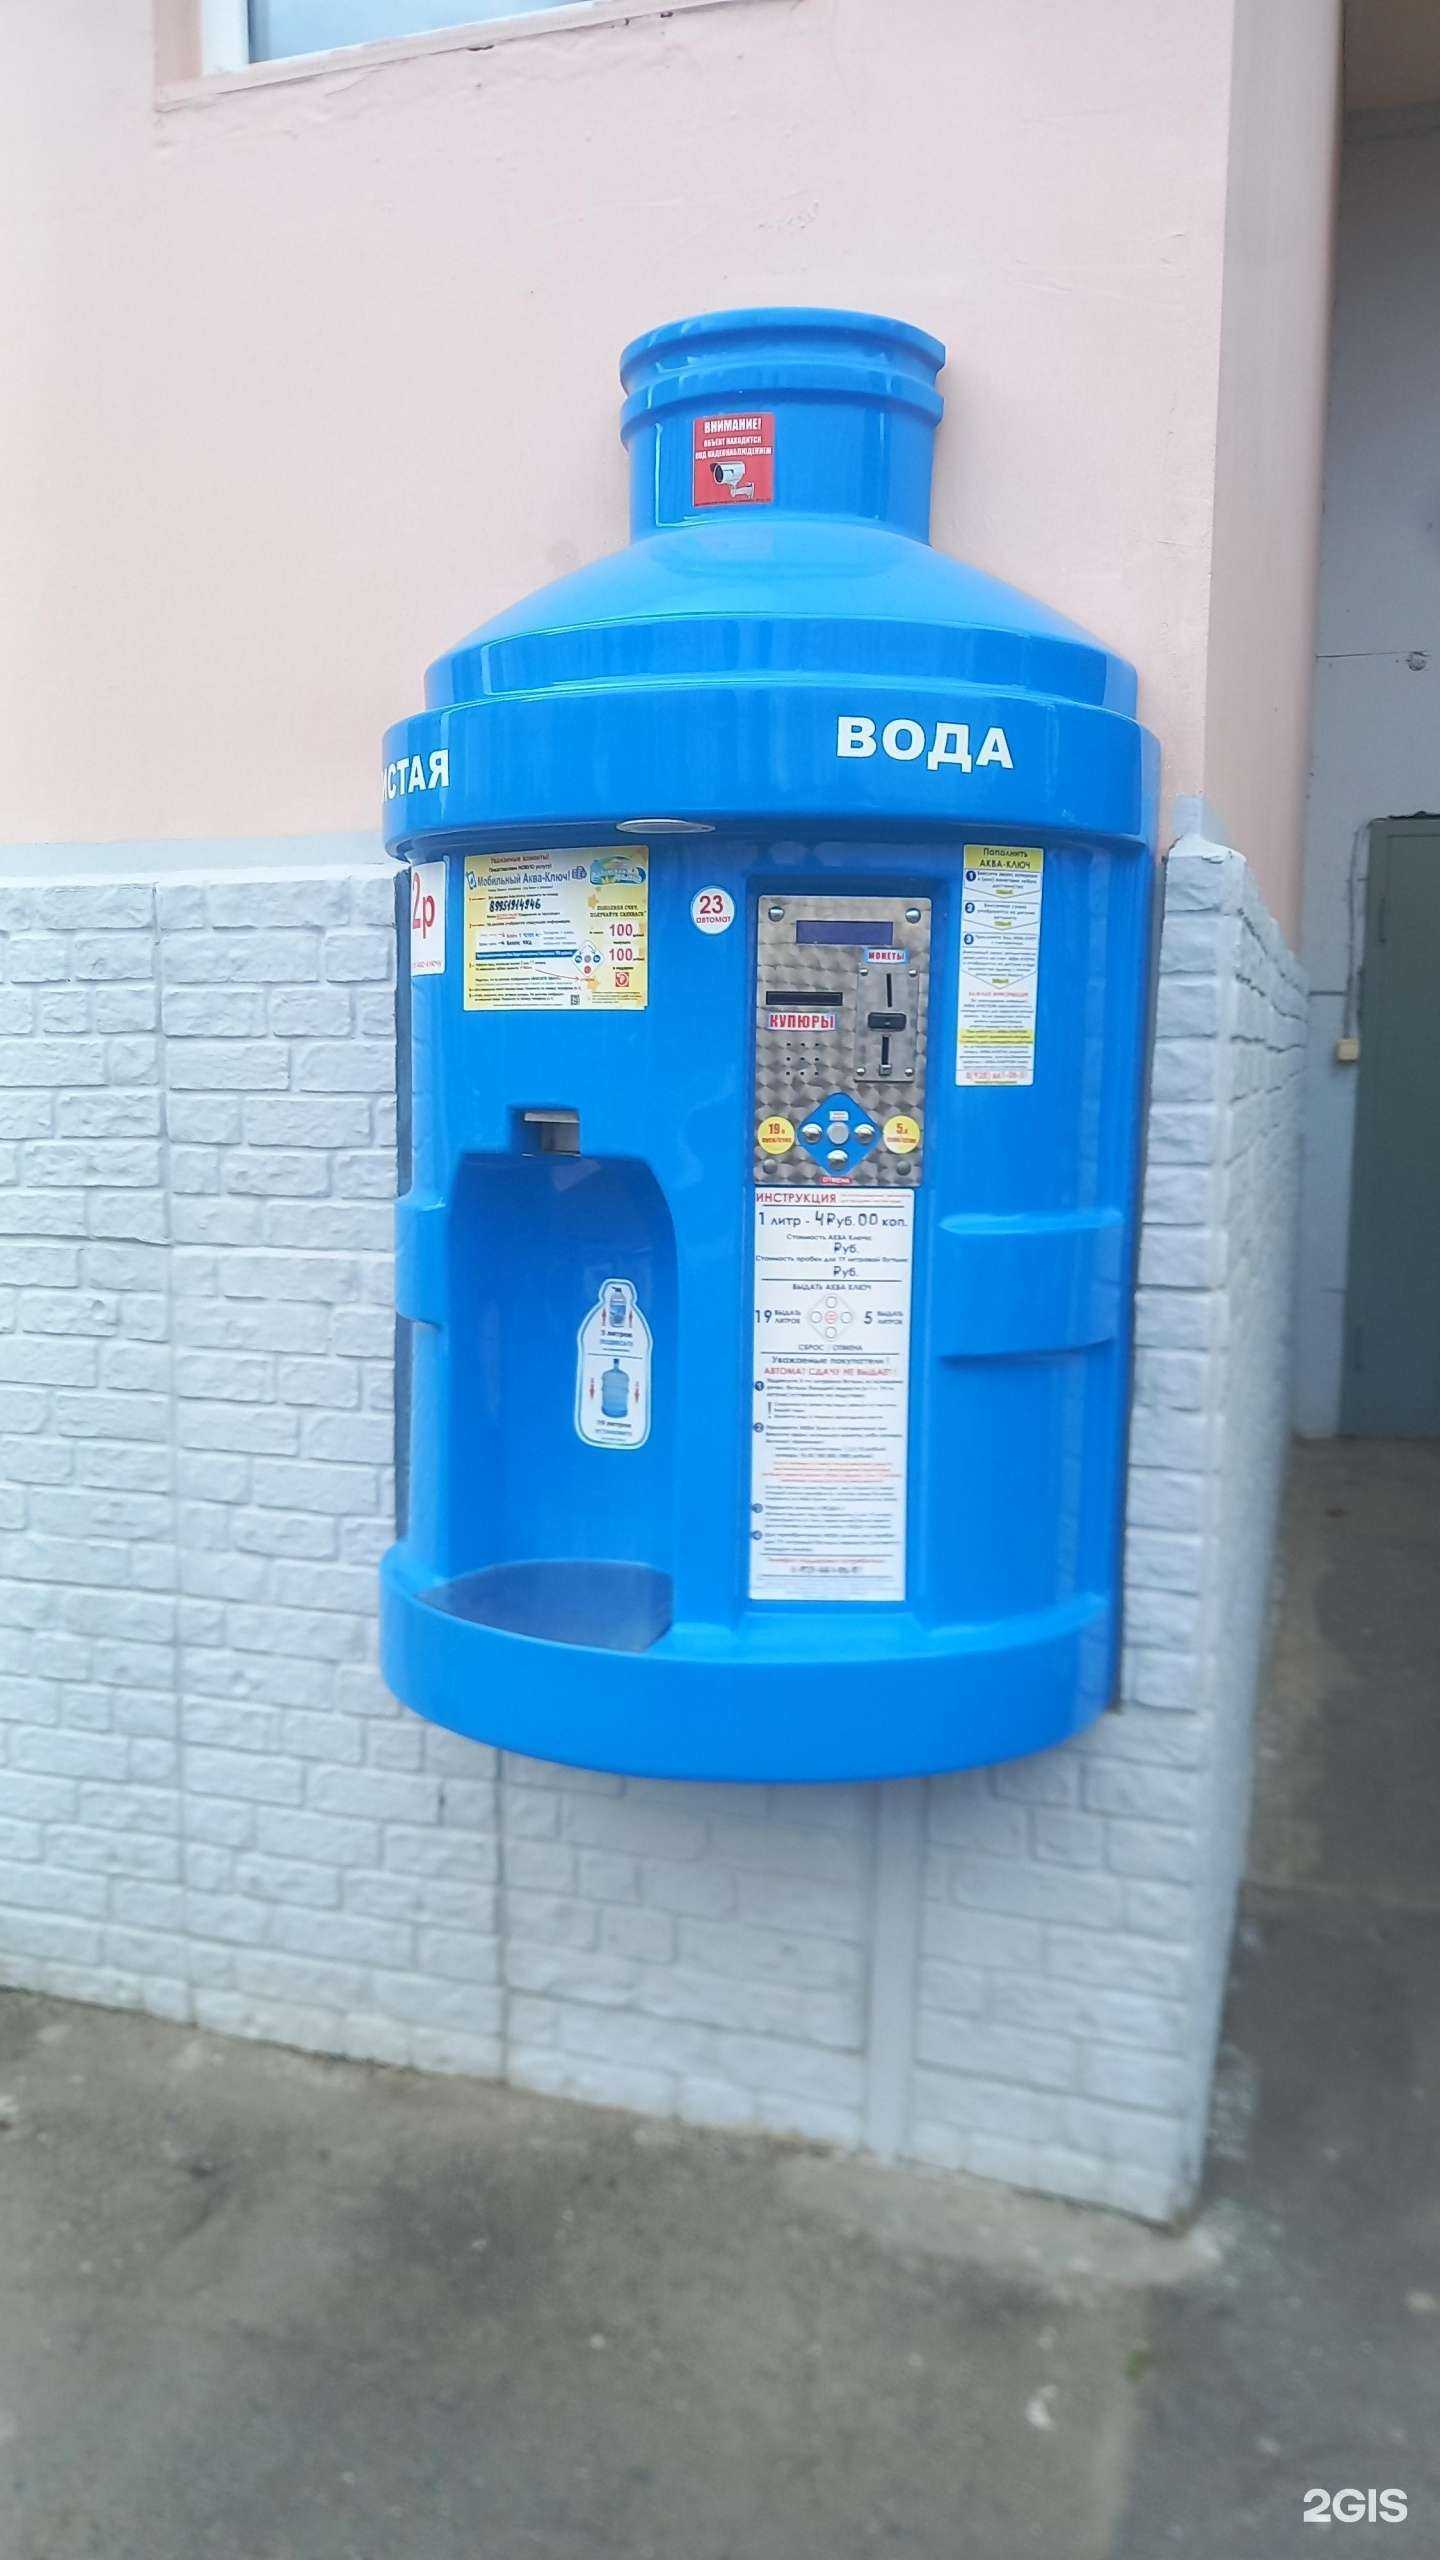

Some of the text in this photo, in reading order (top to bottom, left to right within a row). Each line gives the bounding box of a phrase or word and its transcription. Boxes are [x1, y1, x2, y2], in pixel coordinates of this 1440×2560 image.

[704, 417, 762, 434] ВНИМАНИЕ!
[836, 716, 1014, 773] ВОДА
[983, 848, 1028, 858] Пополнить
[979, 859, 1031, 869] АКВА-КЛЮЧ
[477, 869, 571, 887] Мобильный Аква-Ключ!
[699, 895, 724, 914] 23
[696, 916, 731, 924] автомат
[609, 923, 633, 937] 100
[609, 948, 633, 961] 100
[868, 951, 905, 961] МОНЕТЫ
[769, 1014, 834, 1029] КУПЮРЫ
[768, 1123, 781, 1135] 19
[896, 1123, 903, 1134] 5
[756, 1193, 837, 1204] ИНСТРУКЦИЯ
[758, 1212, 765, 1226] 1
[770, 1218, 801, 1228] литр
[858, 1213, 879, 1227] 00
[882, 1218, 908, 1227] коп.
[792, 1283, 823, 1291] ВЫДАТЬ
[755, 1309, 773, 1324] 19
[864, 1311, 874, 1325] 5
[764, 1367, 806, 1376] АВТОМАТ
[808, 1367, 839, 1376] СДАЧУ
